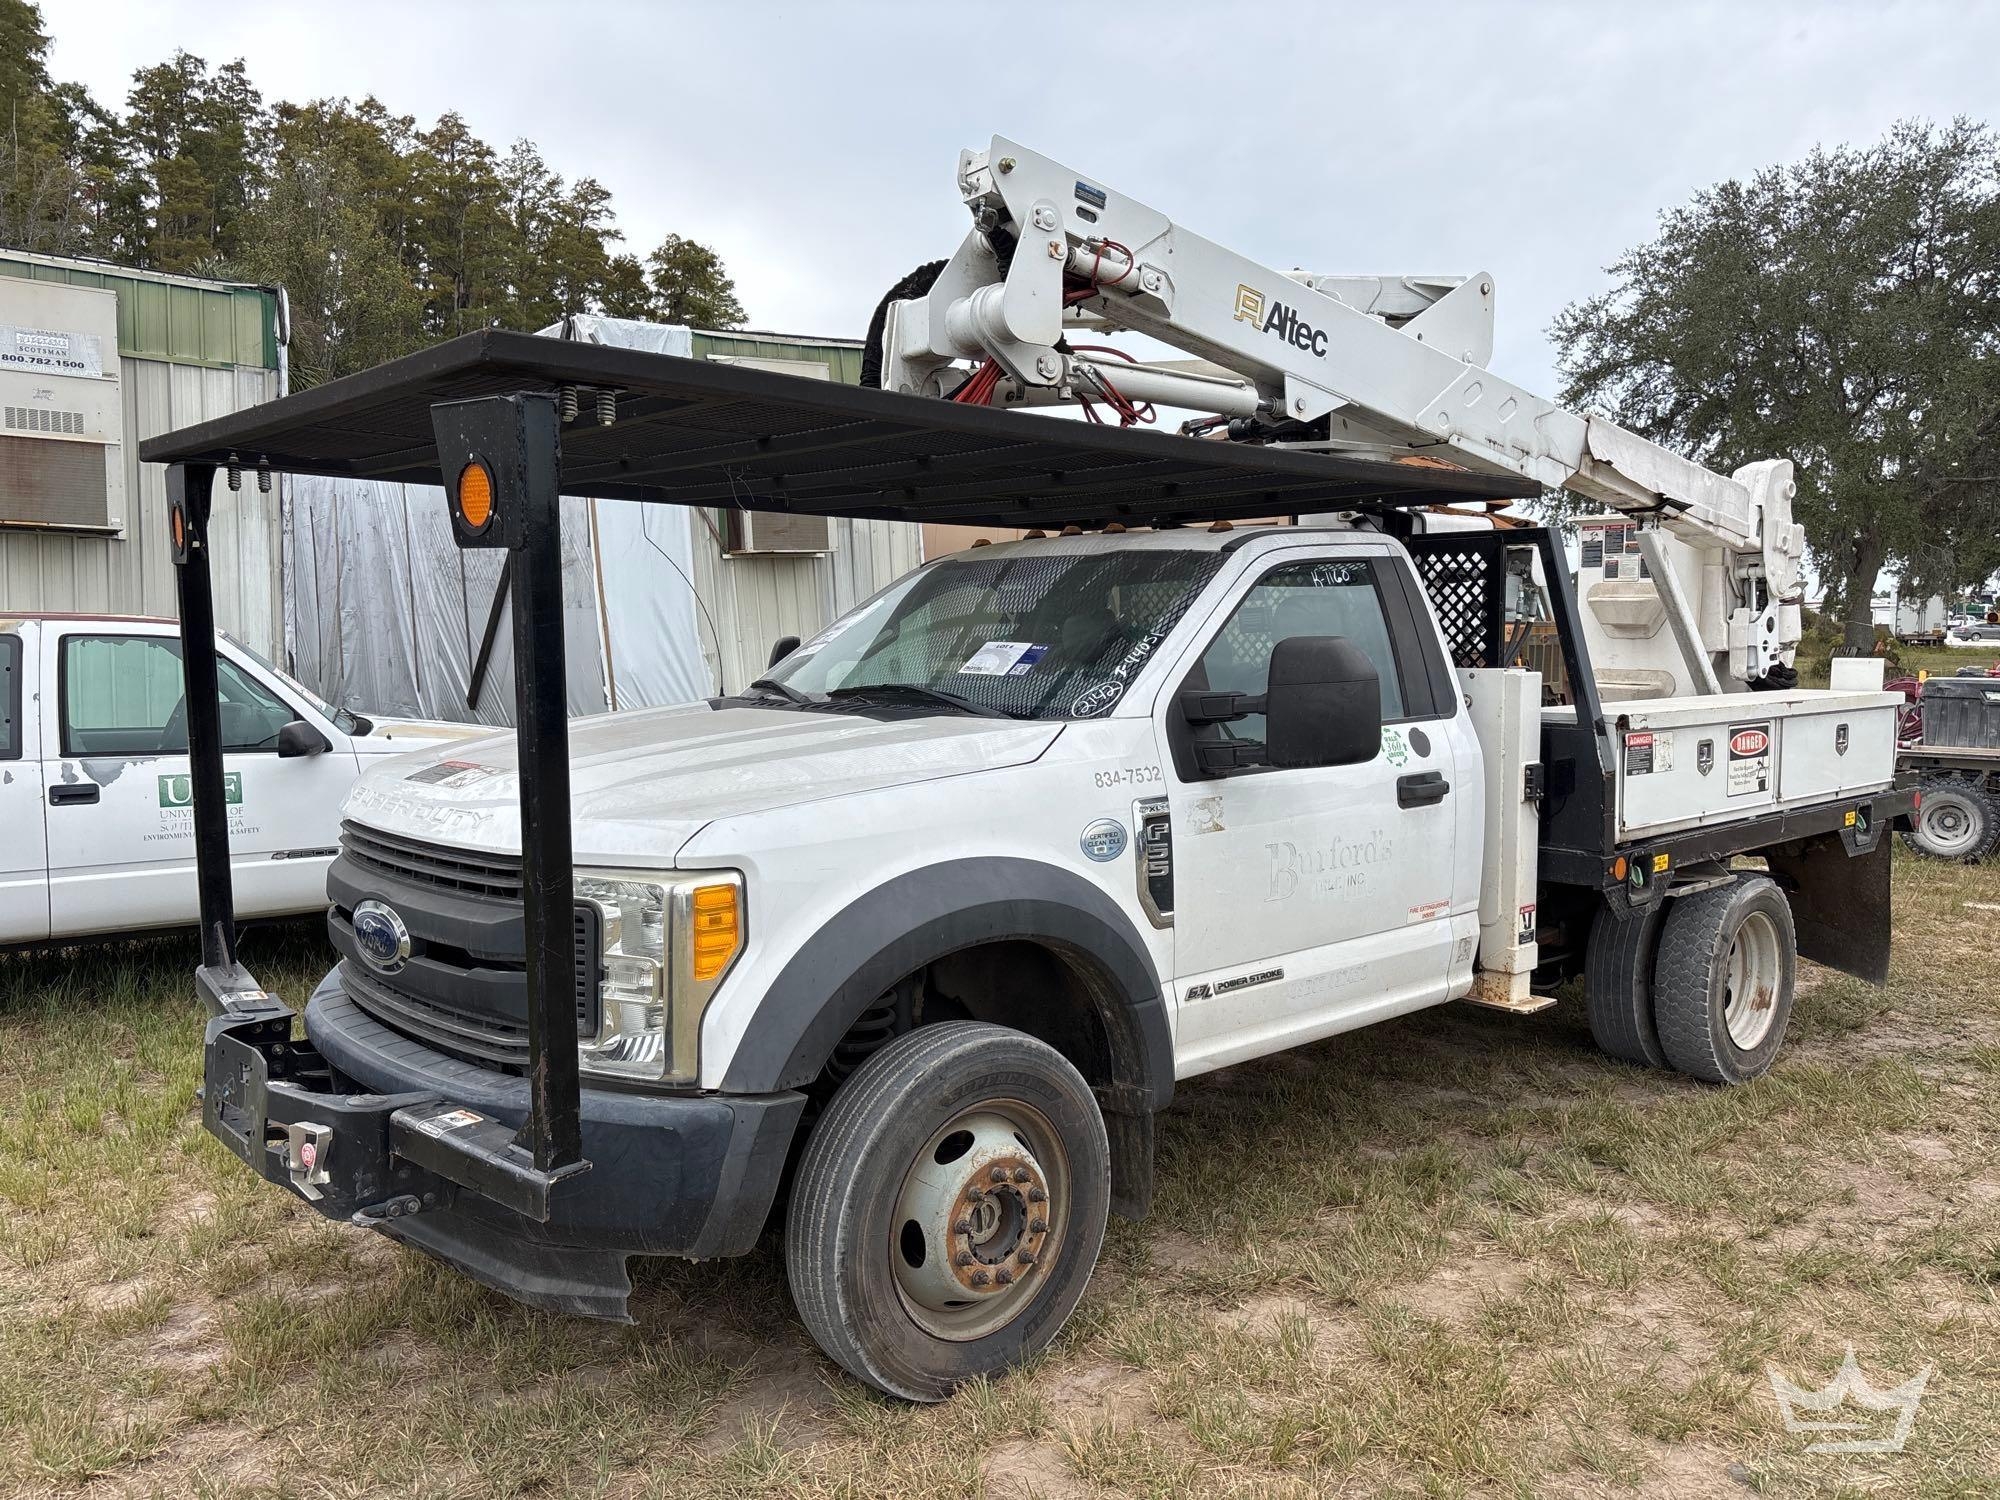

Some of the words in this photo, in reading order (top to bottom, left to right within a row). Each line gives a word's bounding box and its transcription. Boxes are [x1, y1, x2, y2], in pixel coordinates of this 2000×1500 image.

[1262, 301, 1328, 357] Altec
[19, 345, 67, 356] SCOTSMAN
[1, 353, 85, 369] 800.782.1500
[1079, 685, 1123, 713] 2142
[1736, 734, 1763, 751] DANGER
[230, 807, 244, 816] OF
[236, 827, 261, 835] SAFETY
[1089, 831, 1119, 840] CERTIFIED
[1087, 840, 1107, 848] CLEAN
[361, 918, 389, 954] Ford
[1217, 976, 1248, 991] POWER
[1249, 968, 1284, 983] STROKE
